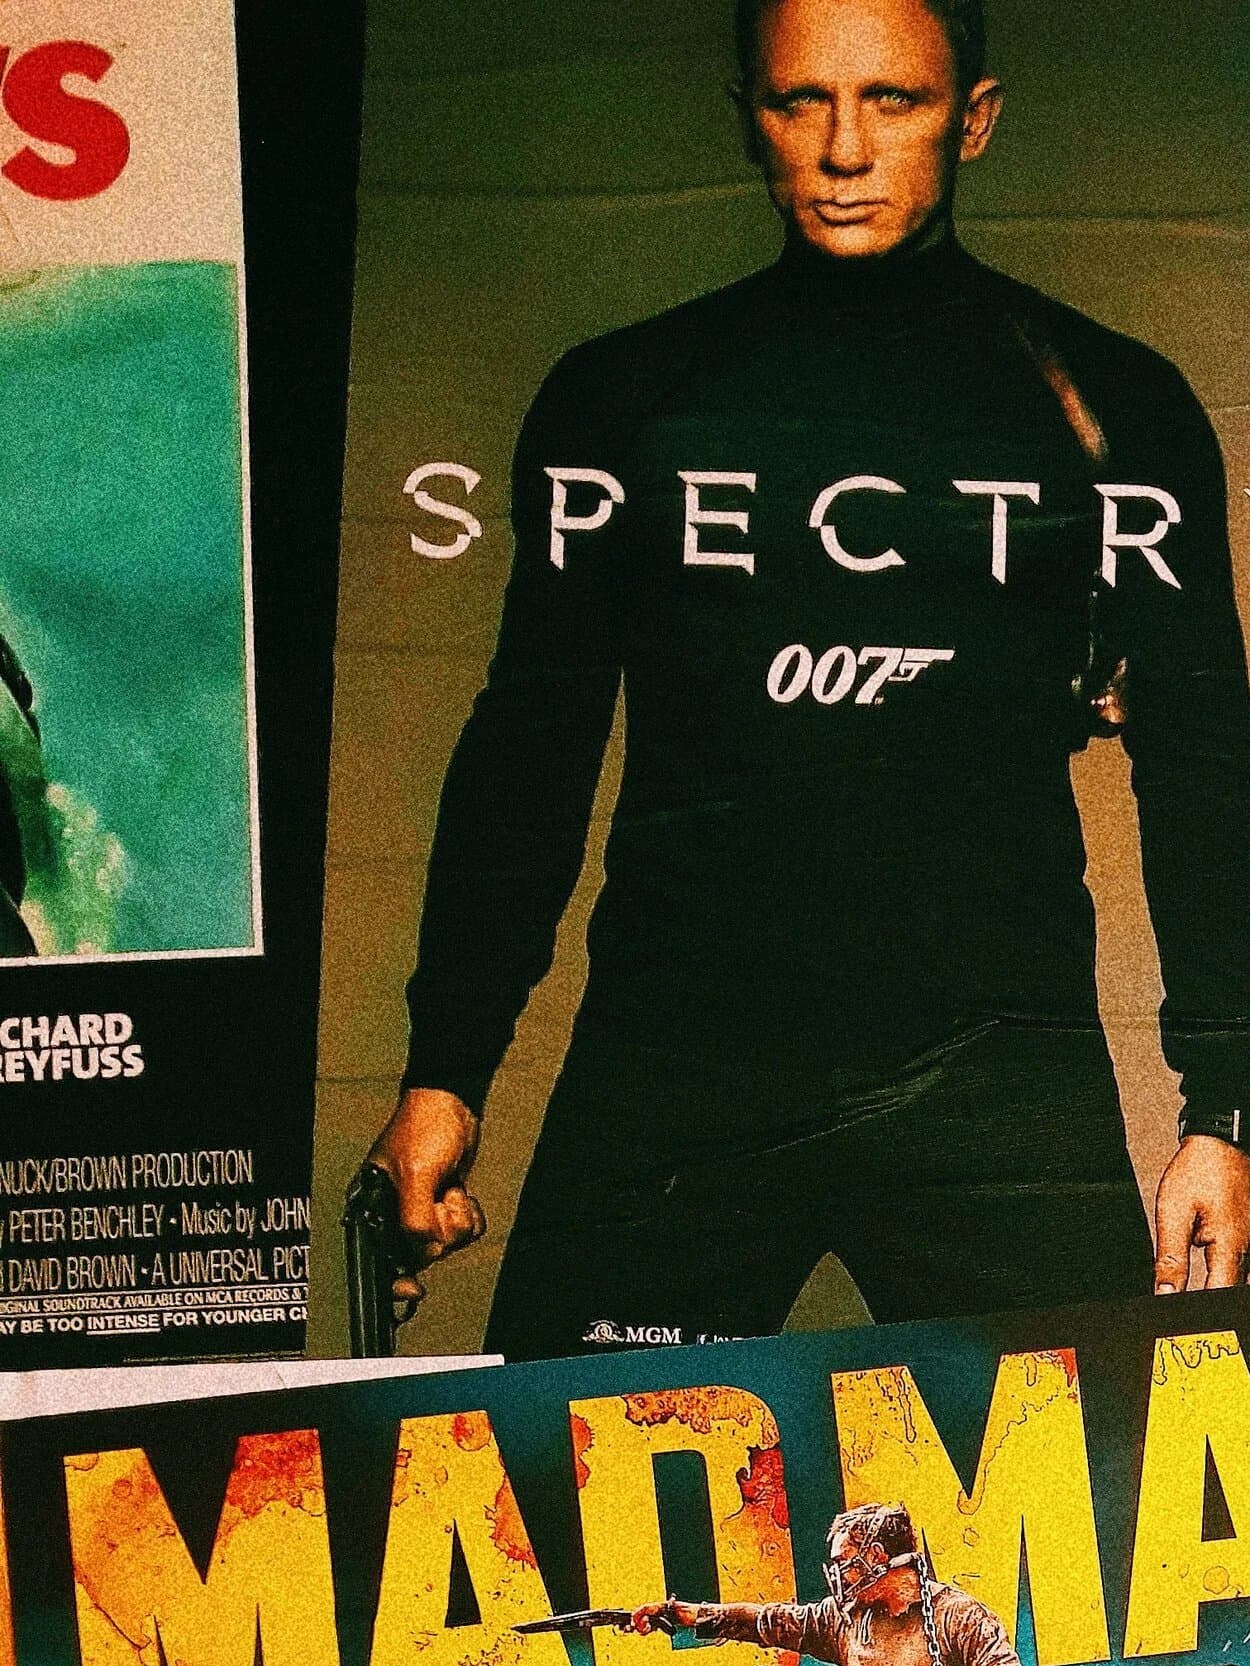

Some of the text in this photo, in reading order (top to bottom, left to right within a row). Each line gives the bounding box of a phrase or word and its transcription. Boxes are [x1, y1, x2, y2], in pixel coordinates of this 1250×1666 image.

[0, 40, 131, 202] S
[766, 644, 955, 706] 007
[0, 1044, 145, 1083] EYFUSS
[131, 1149, 254, 1189] PRODUCTION
[9, 1207, 66, 1243] PETER
[70, 1203, 165, 1241] BENCHLEY
[181, 1201, 232, 1236] Music
[235, 1201, 256, 1240] by
[261, 1197, 312, 1232] JOHN
[8, 1257, 61, 1292] DAVID
[66, 1254, 136, 1290] BROWN
[151, 1252, 167, 1287] A
[169, 1247, 269, 1285] UNIVERSAL
[43, 1295, 121, 1313] SOUNDTRACK
[122, 1291, 182, 1309] AVAILABLE
[184, 1291, 204, 1306] ON
[205, 1289, 233, 1305] MCA
[234, 1287, 290, 1303] RECORDS
[20, 1307, 286, 1334] BE TOO INTENSE FOR YOUNGER
[624, 1327, 682, 1345] MGM
